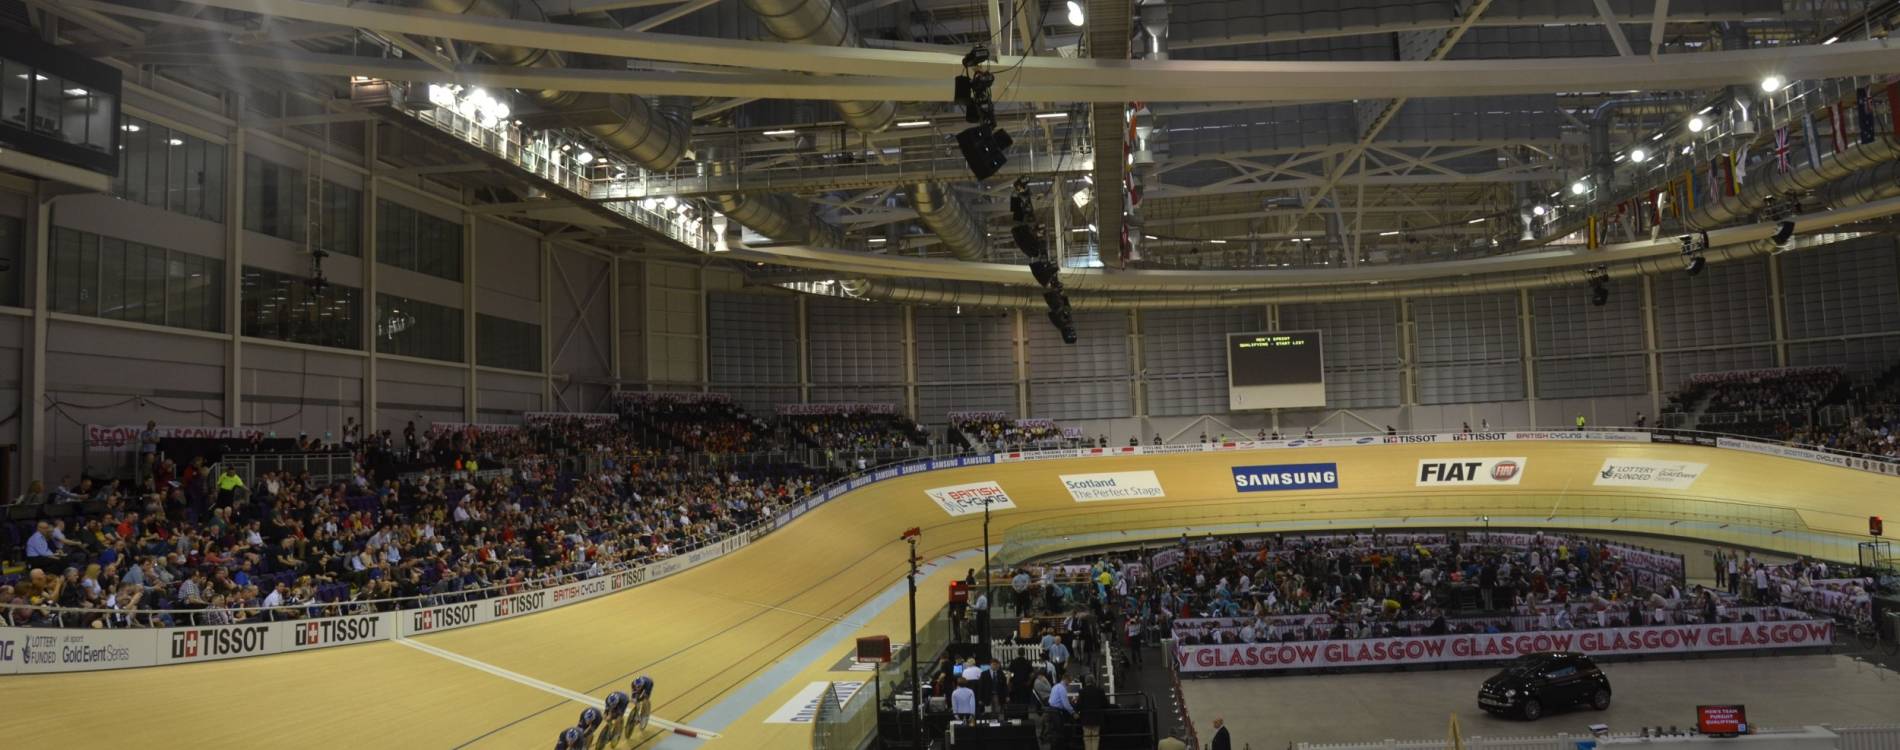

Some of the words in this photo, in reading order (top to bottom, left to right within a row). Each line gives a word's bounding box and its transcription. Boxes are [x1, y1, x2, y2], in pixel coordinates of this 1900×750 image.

[1399, 434, 1437, 443] TISSOT
[1469, 433, 1507, 441] TISSOT
[931, 459, 958, 470] SAMSUNG
[963, 455, 991, 465] SAMSUNG
[875, 467, 898, 481] SAMSUNG
[902, 463, 927, 474] SAMSUNG
[1420, 462, 1483, 482] FIAT
[1496, 465, 1515, 476] FIAT
[1617, 465, 1655, 473] LOTTERY
[1236, 471, 1335, 487] SAMSUNG
[1613, 473, 1652, 481] FUNDED
[1065, 478, 1116, 490] Scotland
[948, 486, 1002, 500] BRITISH
[1072, 490, 1092, 499] The
[1093, 487, 1130, 498] Perfect
[1131, 486, 1161, 496] Stage
[622, 567, 647, 587] TISSOT
[554, 586, 580, 602] BRITISH
[581, 581, 606, 596] CYCLING
[509, 591, 545, 614] TISSOT
[433, 604, 477, 628] TISSOT
[321, 617, 379, 643] TISSOT
[31, 636, 57, 648] LOTTERY
[200, 626, 269, 656] TISSOT
[1196, 644, 1319, 668] GLASGOW
[1324, 638, 1447, 662] GLASGOW
[1452, 633, 1573, 657] GLASGOW
[1579, 628, 1701, 651] GLASGOW
[1708, 622, 1830, 646] GLASGOW
[31, 651, 56, 664] FUNDED
[62, 645, 83, 664] Gold
[83, 645, 107, 663] Event
[107, 644, 129, 662] Series
